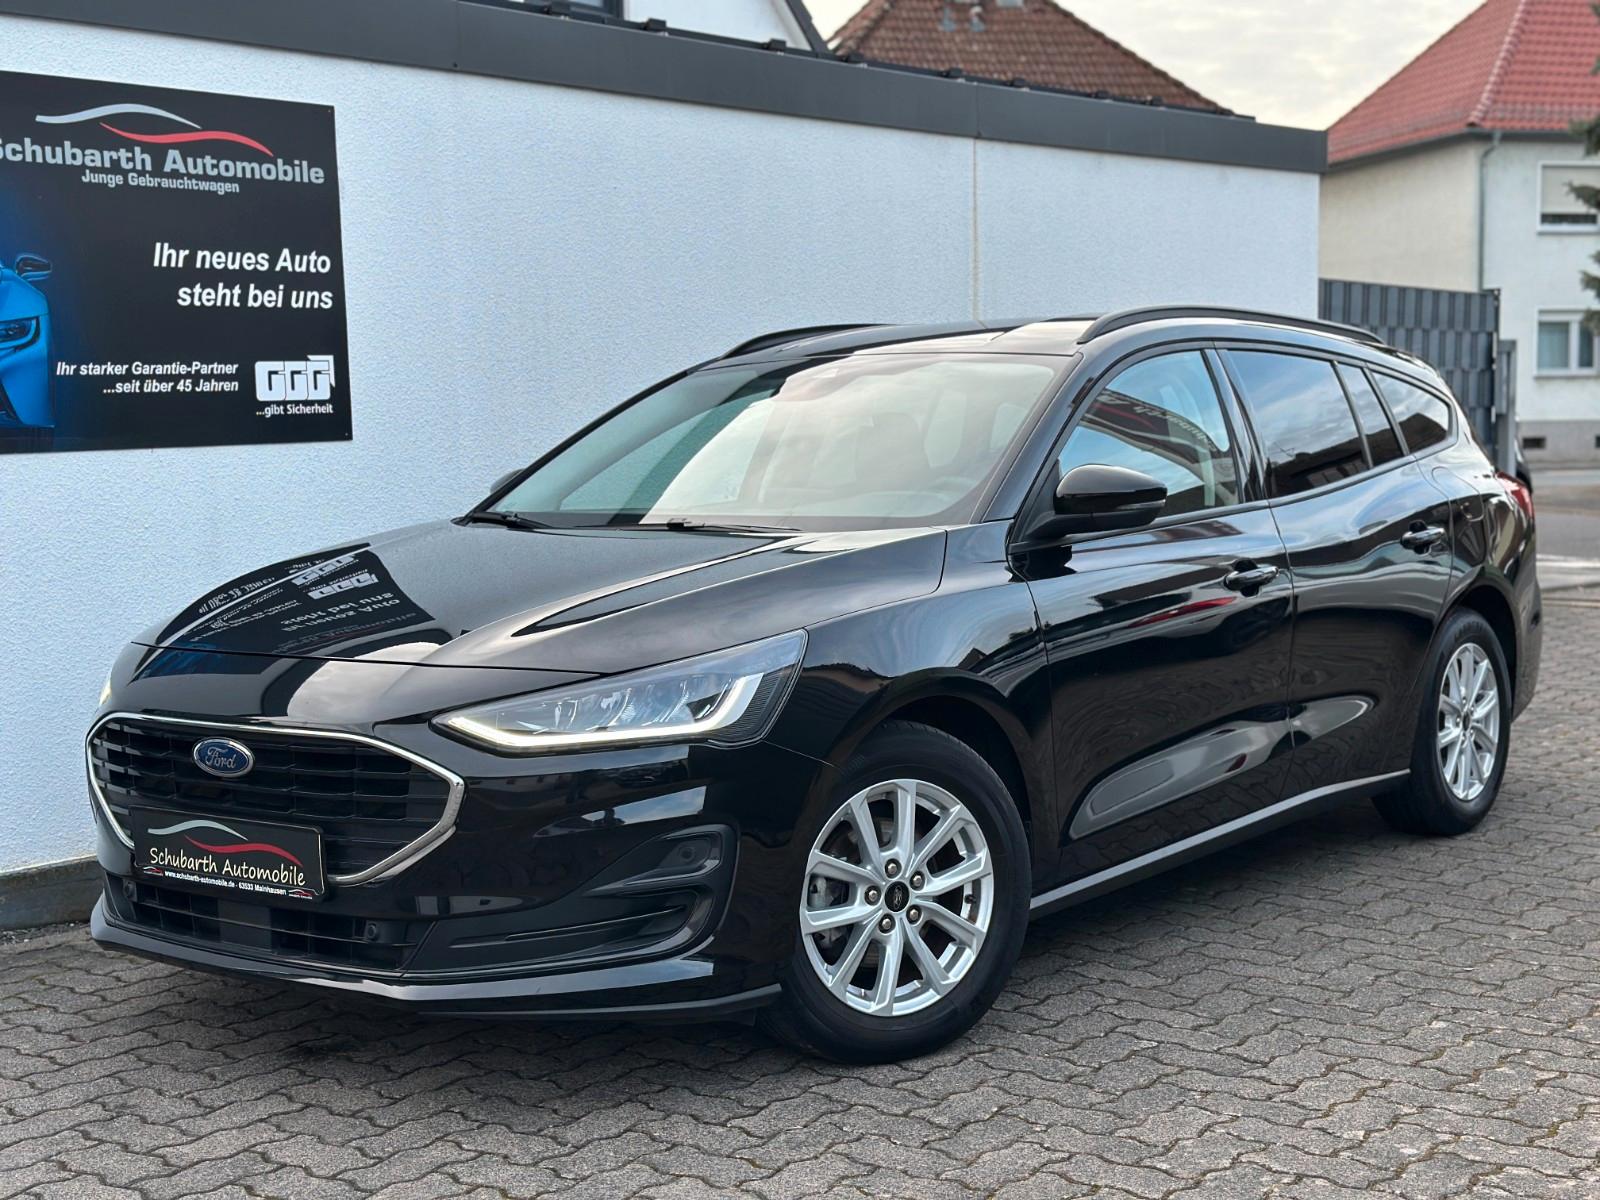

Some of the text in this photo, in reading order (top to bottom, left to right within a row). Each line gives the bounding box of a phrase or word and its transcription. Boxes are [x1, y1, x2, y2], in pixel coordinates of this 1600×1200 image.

[0, 137, 325, 184] chubarth Automobile
[81, 169, 240, 195] Junge Gebrauchtwagen
[153, 241, 332, 274] Ihr neues Auto
[176, 281, 334, 310] steht bei uns
[56, 361, 239, 376] Ihr starker Garantie-Partner
[143, 378, 175, 393] über
[176, 378, 193, 393] 45
[194, 378, 239, 392] Jahren
[286, 402, 334, 415] Sicherheit
[204, 745, 238, 770] Ford
[149, 847, 307, 887] Schubarth Automobile
